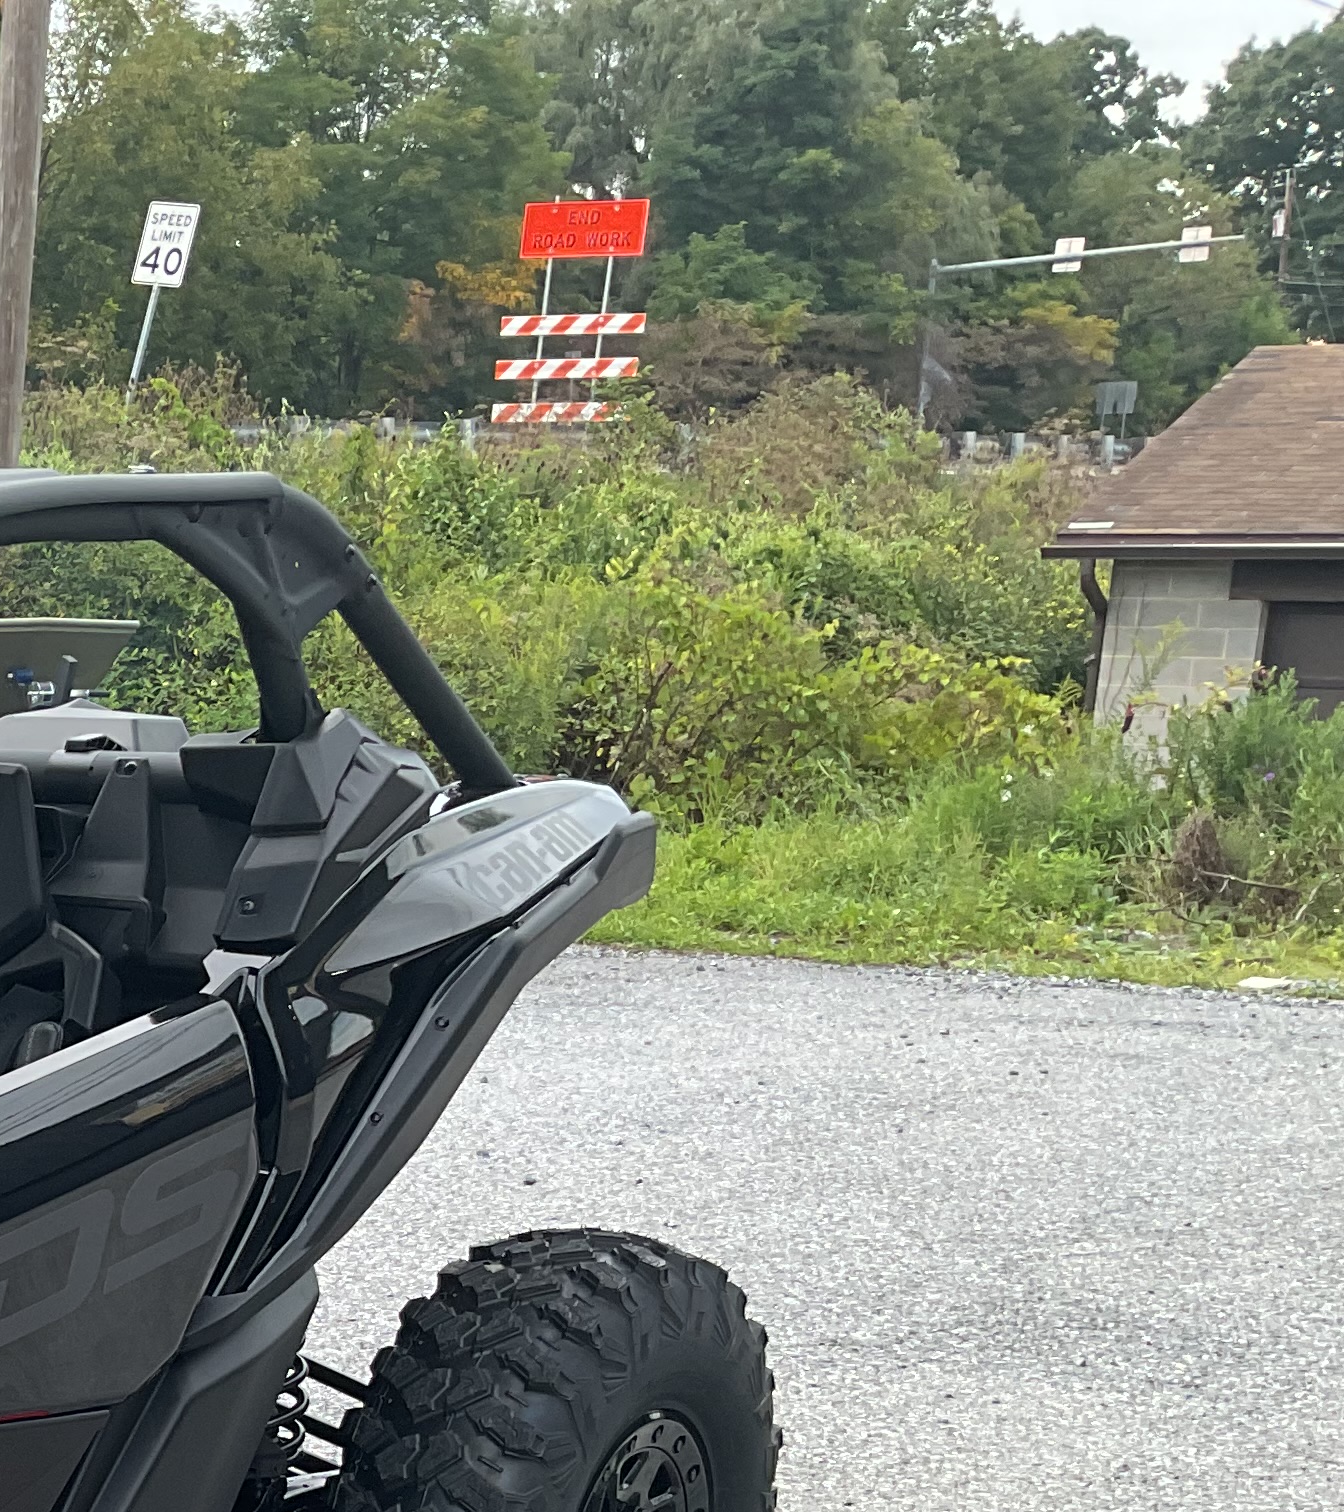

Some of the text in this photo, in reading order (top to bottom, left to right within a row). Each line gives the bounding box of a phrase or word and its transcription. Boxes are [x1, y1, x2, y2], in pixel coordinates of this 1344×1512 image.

[151, 212, 193, 227] SPEED
[568, 210, 602, 226] END
[151, 229, 184, 243] LIMIT
[533, 231, 632, 249] ROAD WORK
[140, 246, 183, 276] 40
[470, 808, 597, 906] can-am
